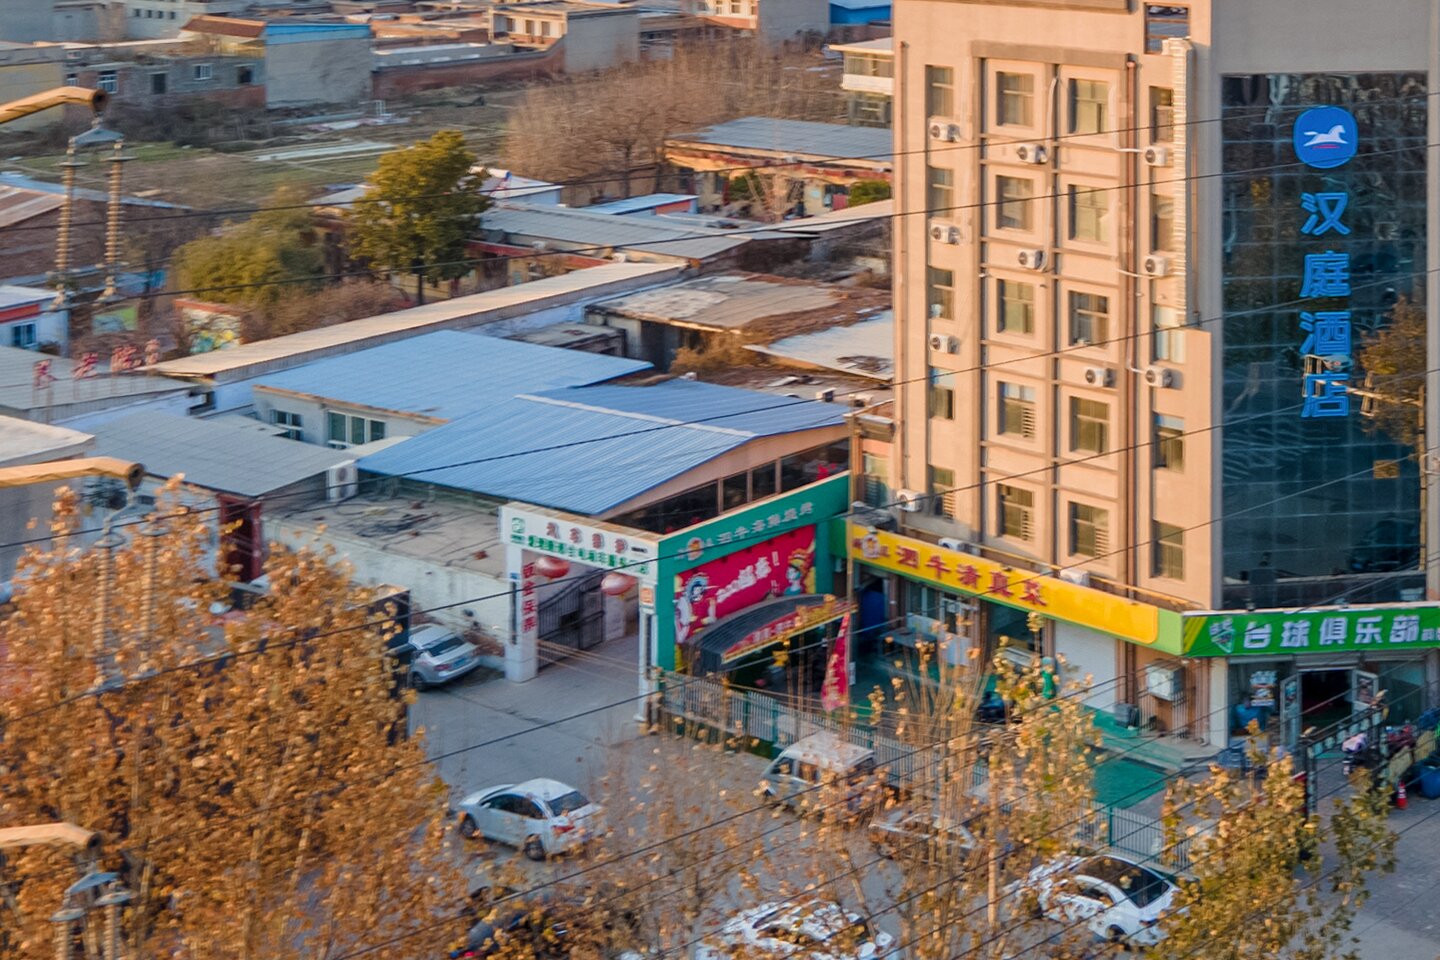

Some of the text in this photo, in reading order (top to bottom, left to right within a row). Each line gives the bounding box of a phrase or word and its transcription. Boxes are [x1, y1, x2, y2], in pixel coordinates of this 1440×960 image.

[1299, 192, 1352, 418] 汉庭酒店
[1243, 615, 1420, 650] 台球俱乐部
